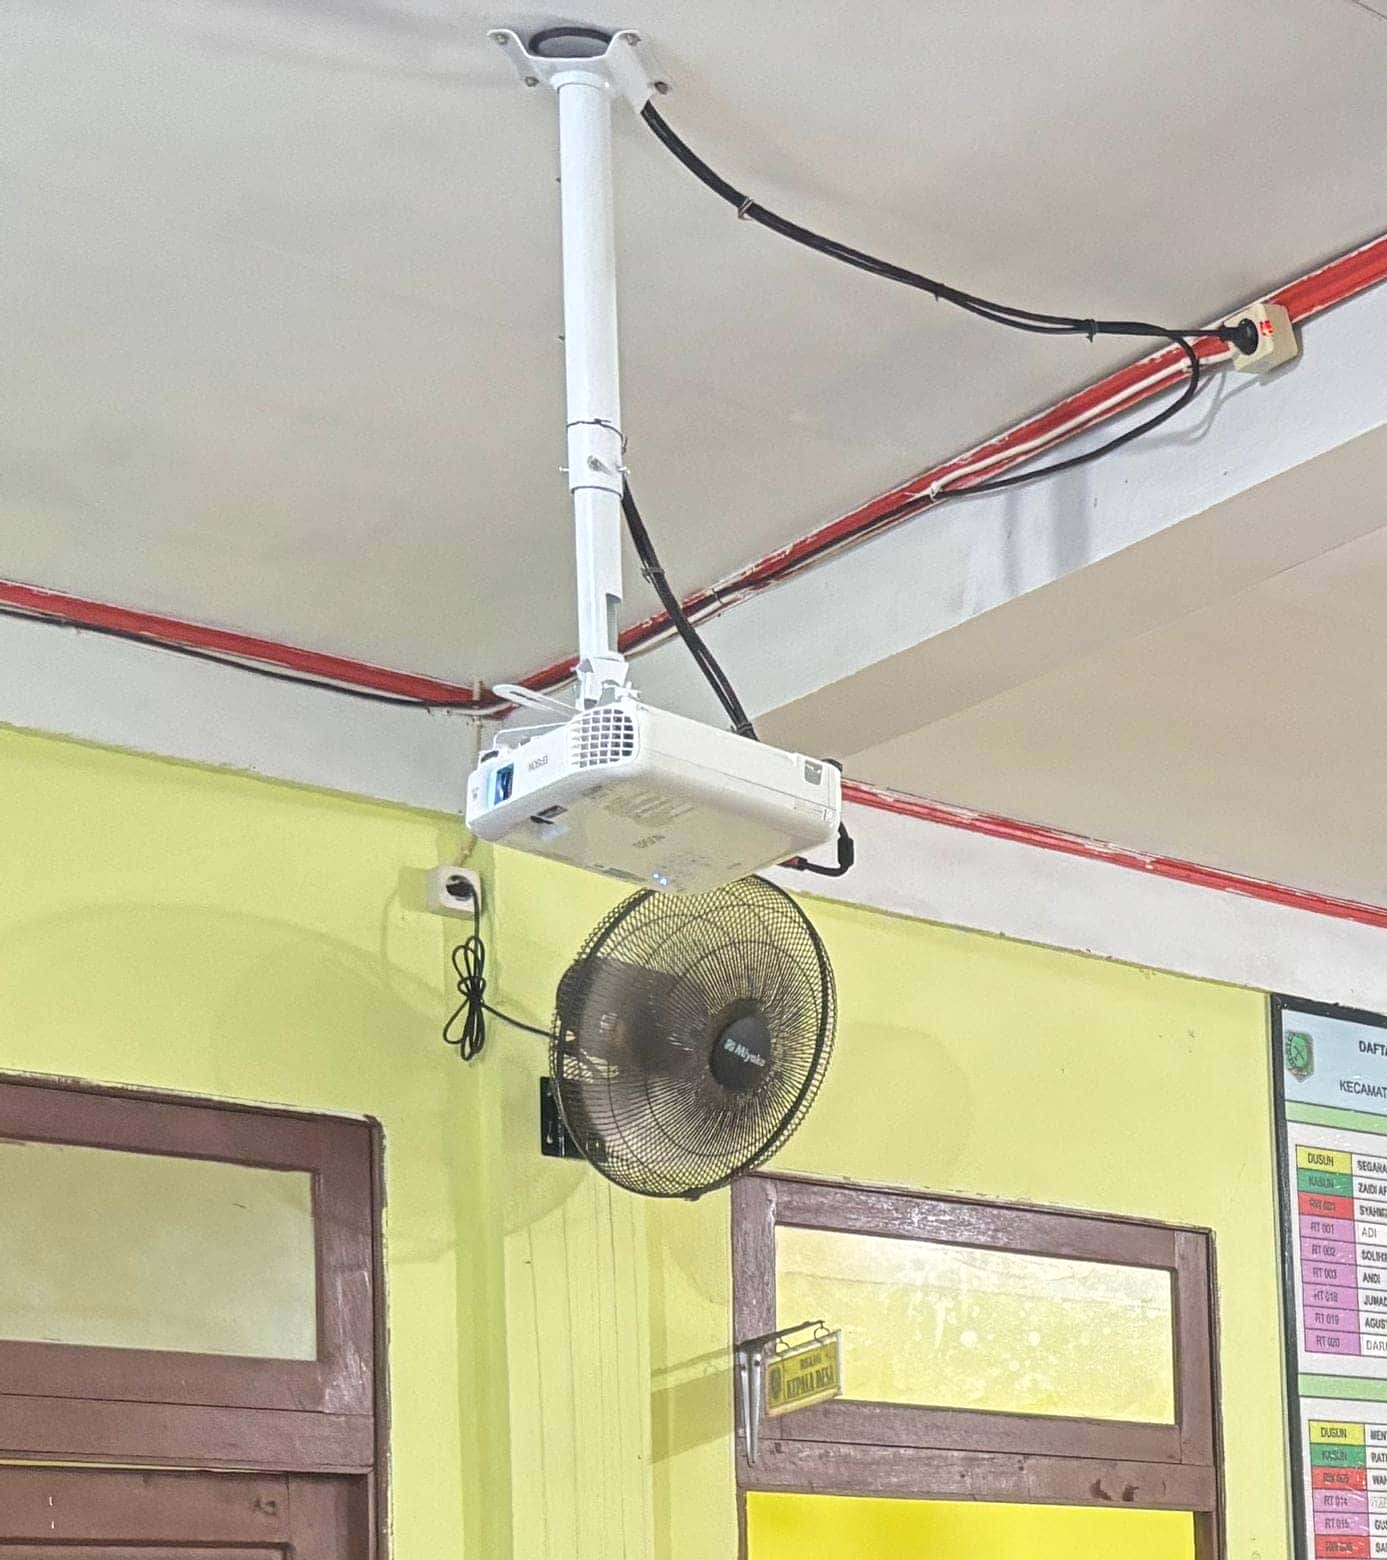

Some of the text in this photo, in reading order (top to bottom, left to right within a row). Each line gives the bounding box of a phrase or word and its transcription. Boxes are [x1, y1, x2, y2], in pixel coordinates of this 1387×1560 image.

[1308, 1152, 1334, 1167] DUSUN
[1362, 1227, 1377, 1238] ADI
[787, 1372, 815, 1400] KEPALA
